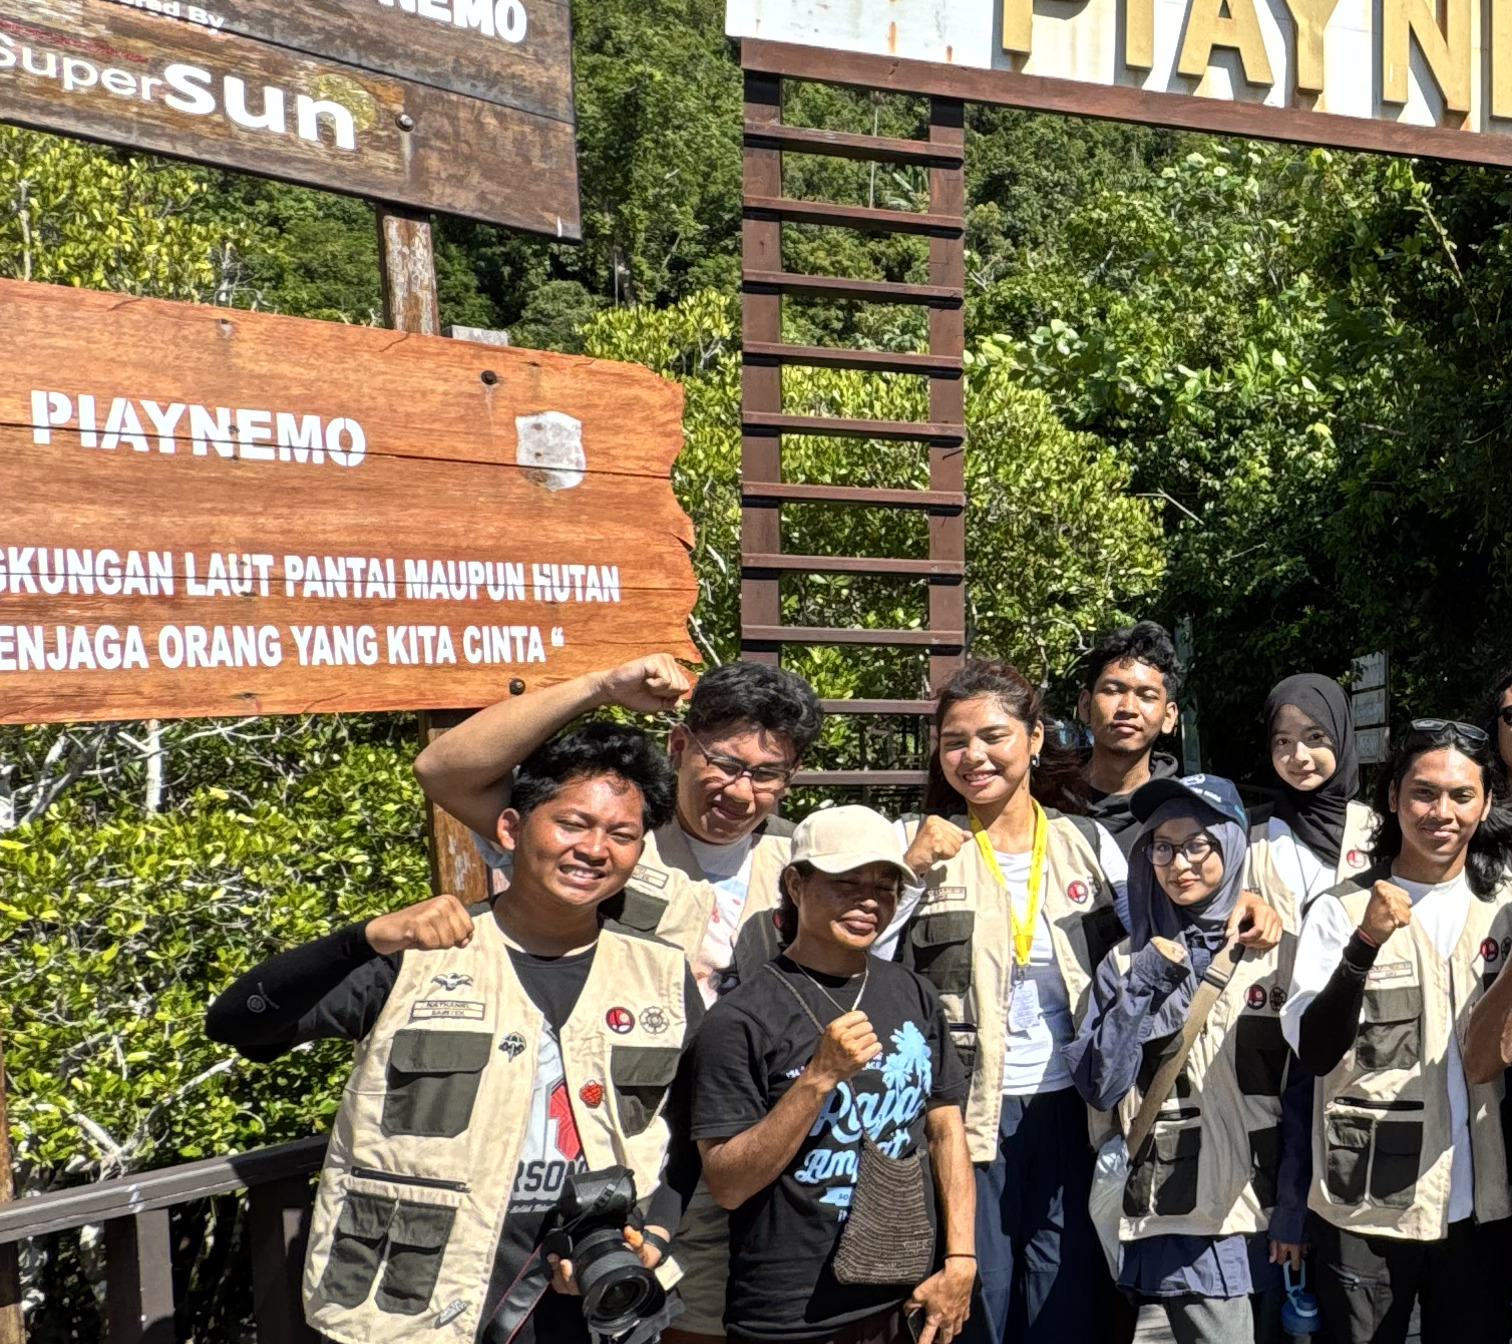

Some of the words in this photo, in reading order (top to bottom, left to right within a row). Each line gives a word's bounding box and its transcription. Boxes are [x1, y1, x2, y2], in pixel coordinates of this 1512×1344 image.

[188, 5, 225, 35] By
[31, 390, 367, 467] PIAYNEMO
[0, 547, 174, 595] KUNGAN
[185, 552, 274, 597] LAUT
[284, 555, 396, 599] PANTAI
[404, 559, 525, 601] MAUPUN
[532, 563, 620, 602] HUTAN
[0, 624, 150, 671] ENJAGA
[158, 624, 282, 669] ORANG
[291, 624, 379, 666] YANG
[387, 624, 456, 665] KITA
[809, 1081, 926, 1144] Raja
